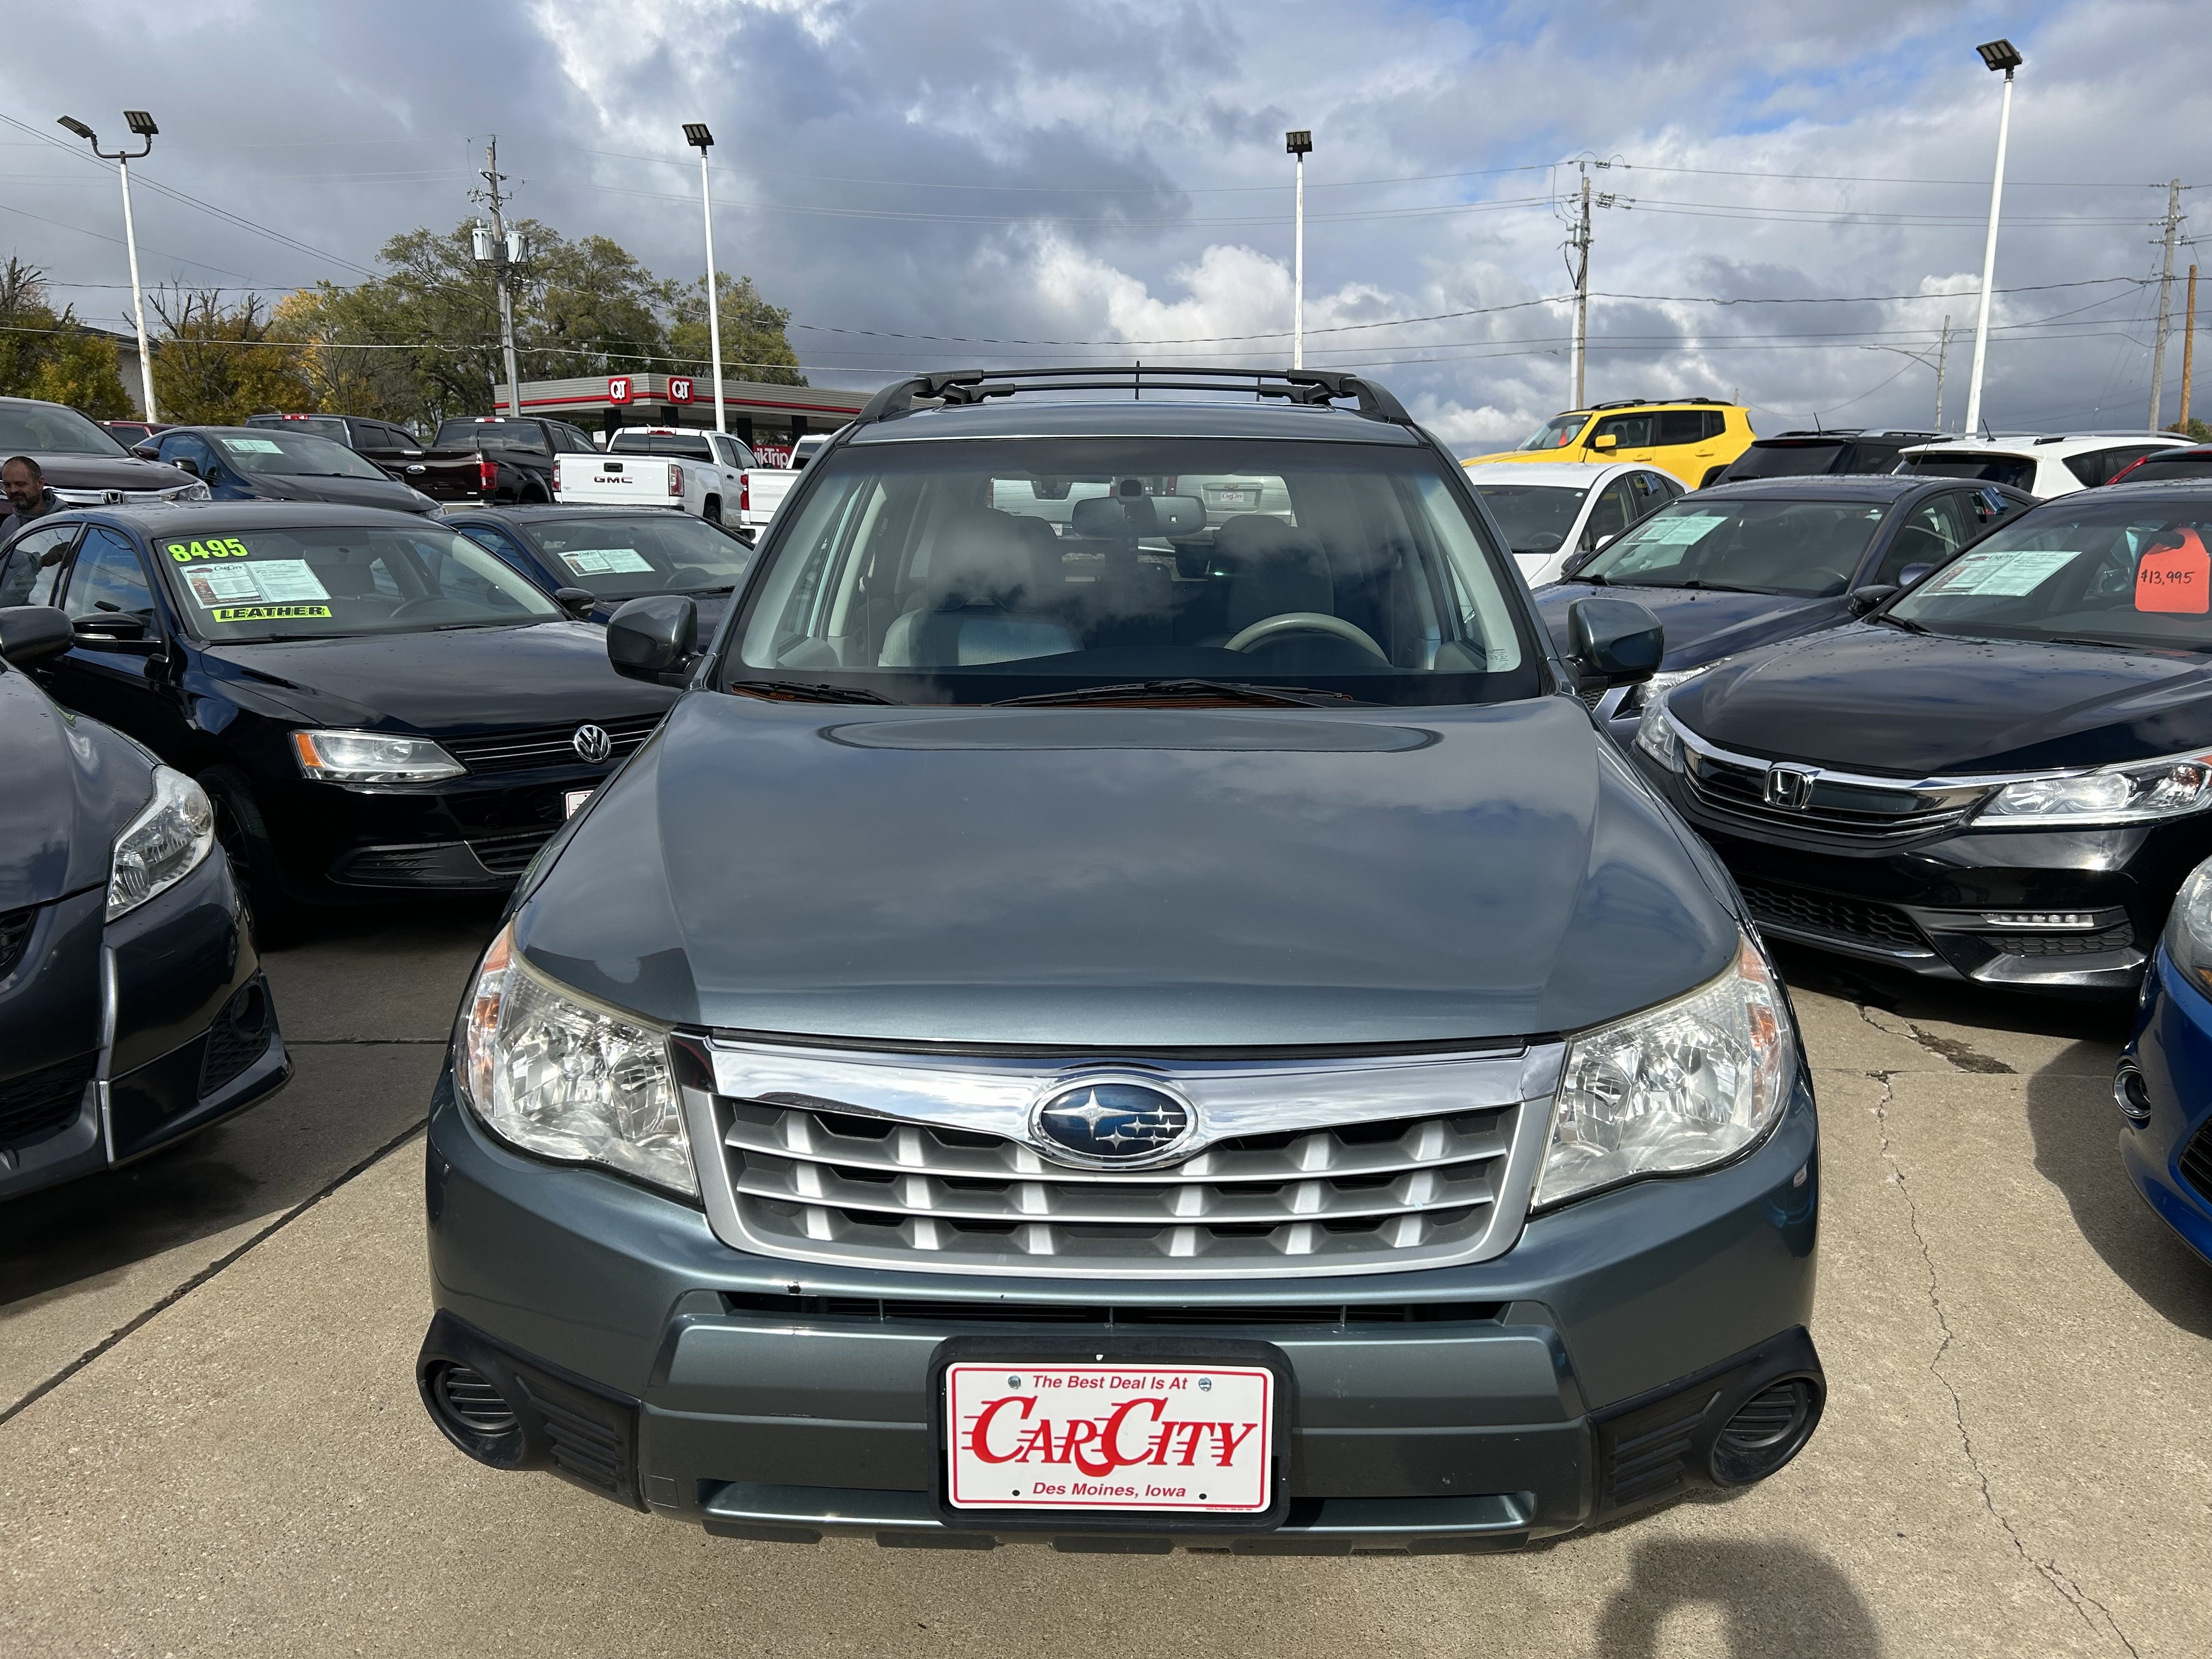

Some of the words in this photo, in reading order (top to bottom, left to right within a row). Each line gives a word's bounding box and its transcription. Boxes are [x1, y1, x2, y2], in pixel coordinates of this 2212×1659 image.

[610, 380, 627, 400] QT
[672, 380, 690, 400] QT
[754, 447, 789, 469] ikTrip
[594, 476, 633, 484] GMC
[168, 538, 249, 562] 8495
[2141, 569, 2196, 585] $13,995
[219, 606, 326, 620] LEATHER
[1032, 1375, 1063, 1388] The
[1067, 1375, 1105, 1389] Best
[1109, 1376, 1147, 1389] Deal
[1150, 1376, 1165, 1390] Is
[1168, 1377, 1188, 1390] At
[1032, 1482, 1066, 1495] Des
[1071, 1483, 1139, 1498] Moines,
[1145, 1485, 1187, 1497] Iowa
